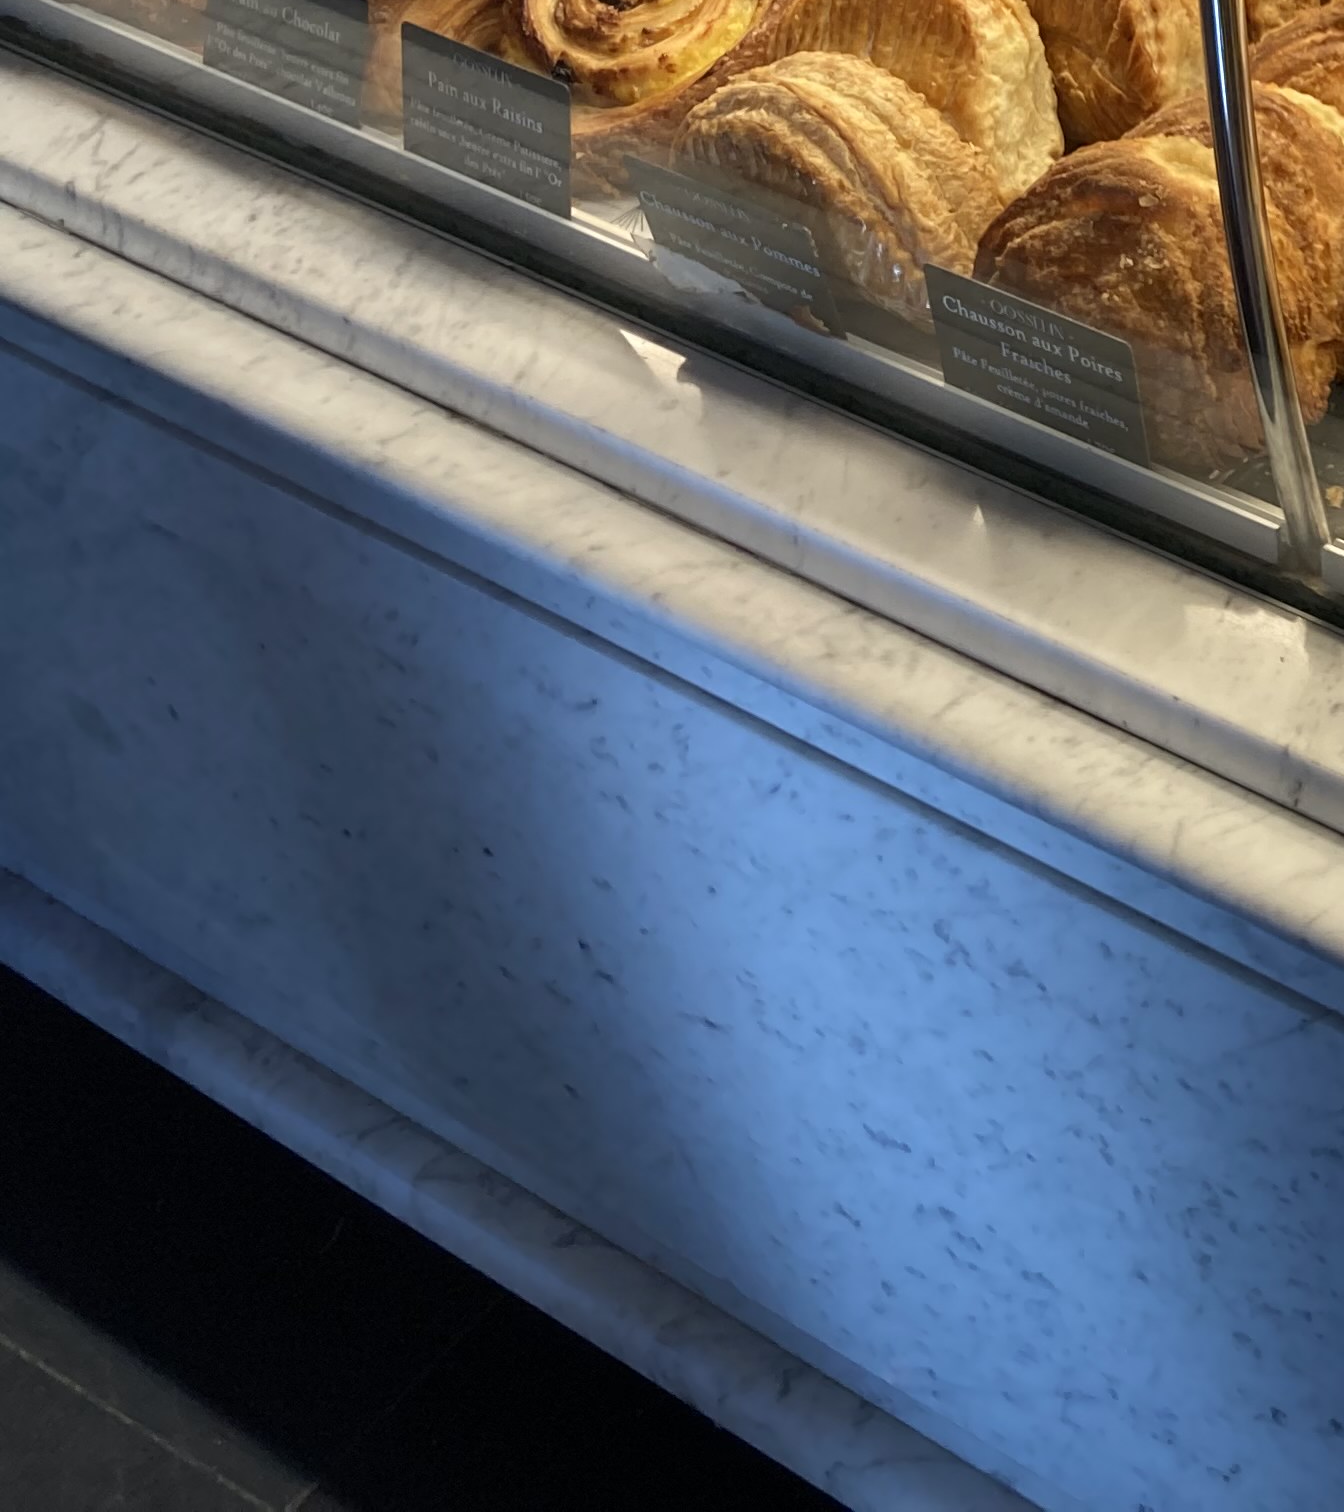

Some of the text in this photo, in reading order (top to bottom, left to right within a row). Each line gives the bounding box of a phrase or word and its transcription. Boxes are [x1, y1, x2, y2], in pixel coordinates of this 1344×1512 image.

[282, 7, 341, 44] Chocolat
[428, 71, 459, 99] Pain
[462, 91, 487, 111] aux
[492, 97, 543, 134] Raisins
[640, 190, 716, 232] Chausson
[721, 229, 749, 247] aux
[751, 235, 821, 277] Pommes
[942, 295, 1123, 382] Chausson aux Poires
[989, 299, 1065, 341] GOSSELIN
[952, 346, 977, 366] Pâte
[1000, 341, 1072, 385] Fraiches
[997, 384, 1031, 404] crème
